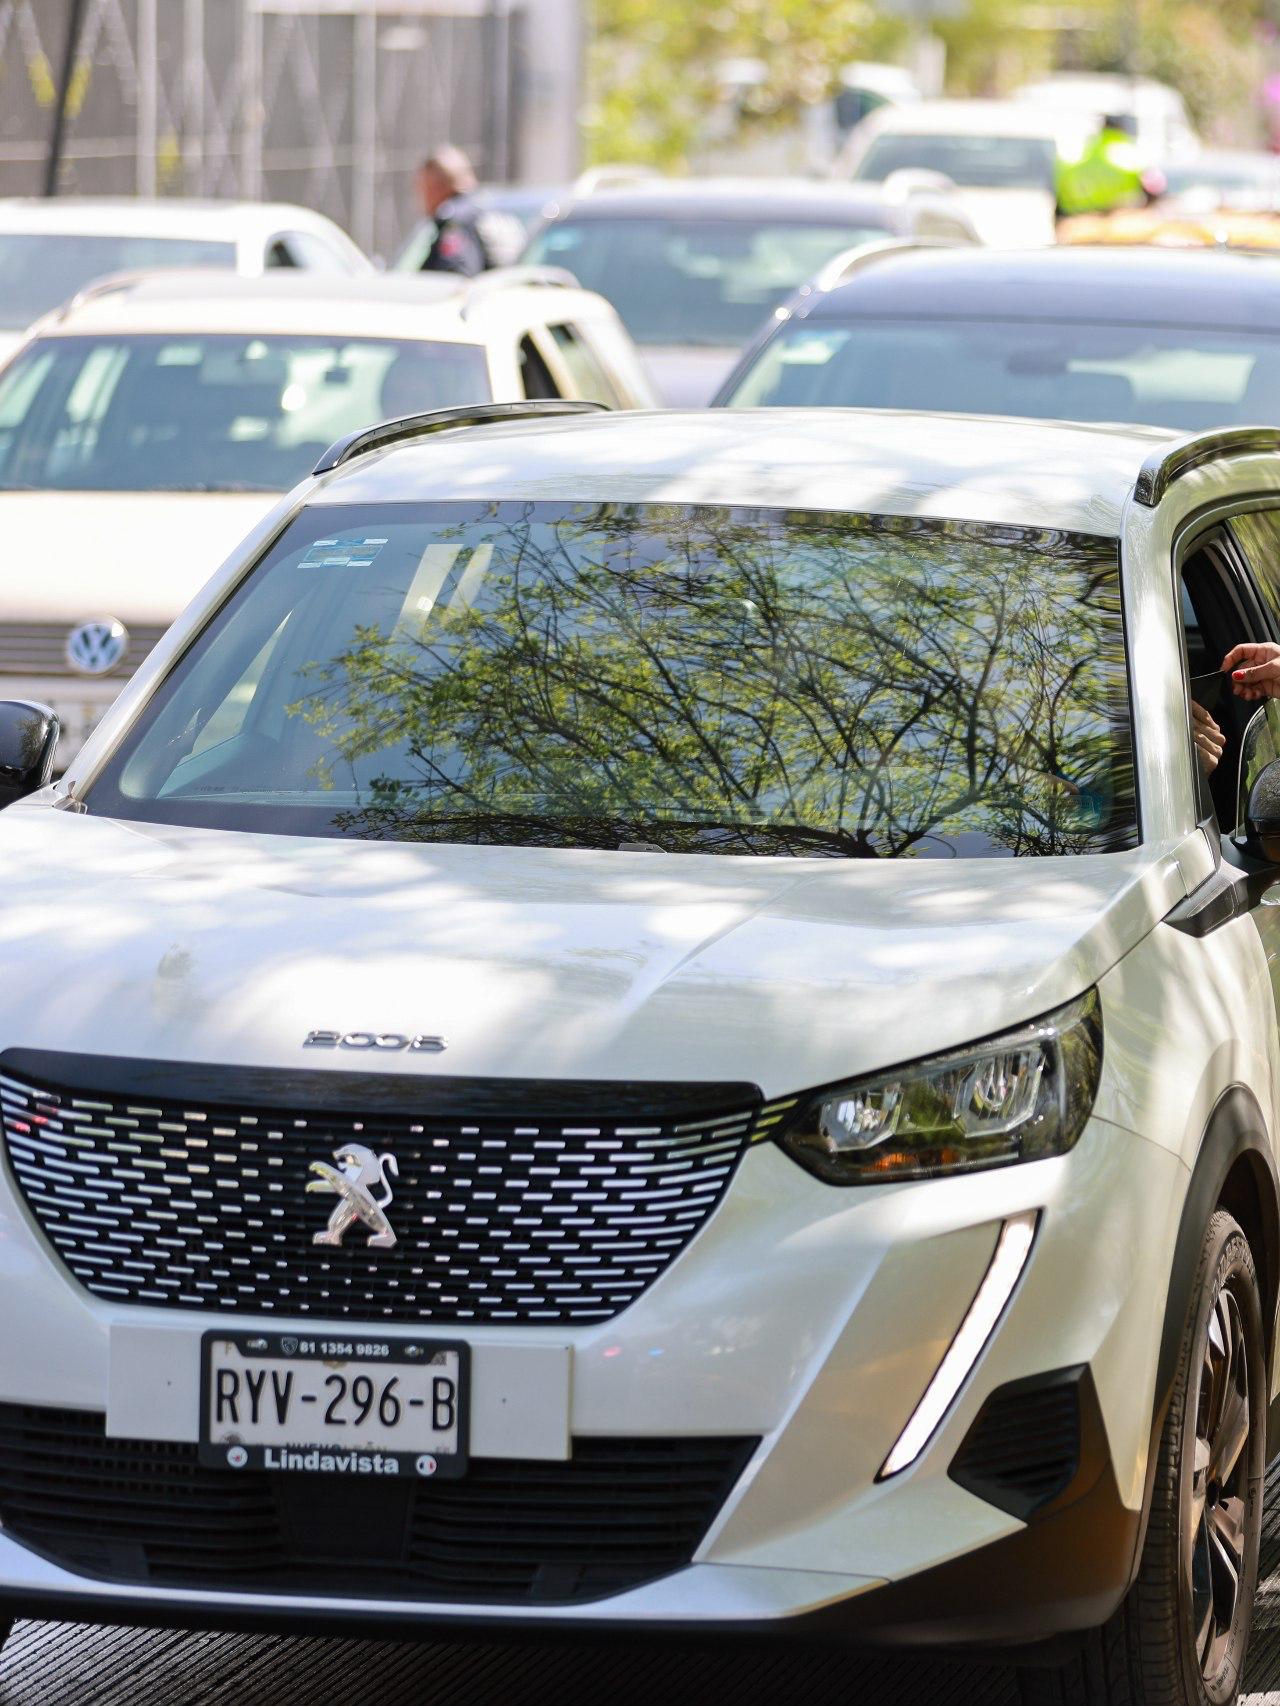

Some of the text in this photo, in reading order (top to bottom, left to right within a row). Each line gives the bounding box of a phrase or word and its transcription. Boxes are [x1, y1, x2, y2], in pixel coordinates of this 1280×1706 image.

[299, 1341, 316, 1353] 81
[320, 1342, 353, 1355] 1354
[216, 1369, 456, 1431] RYV-296-B
[264, 1448, 400, 1474] Lindavista
